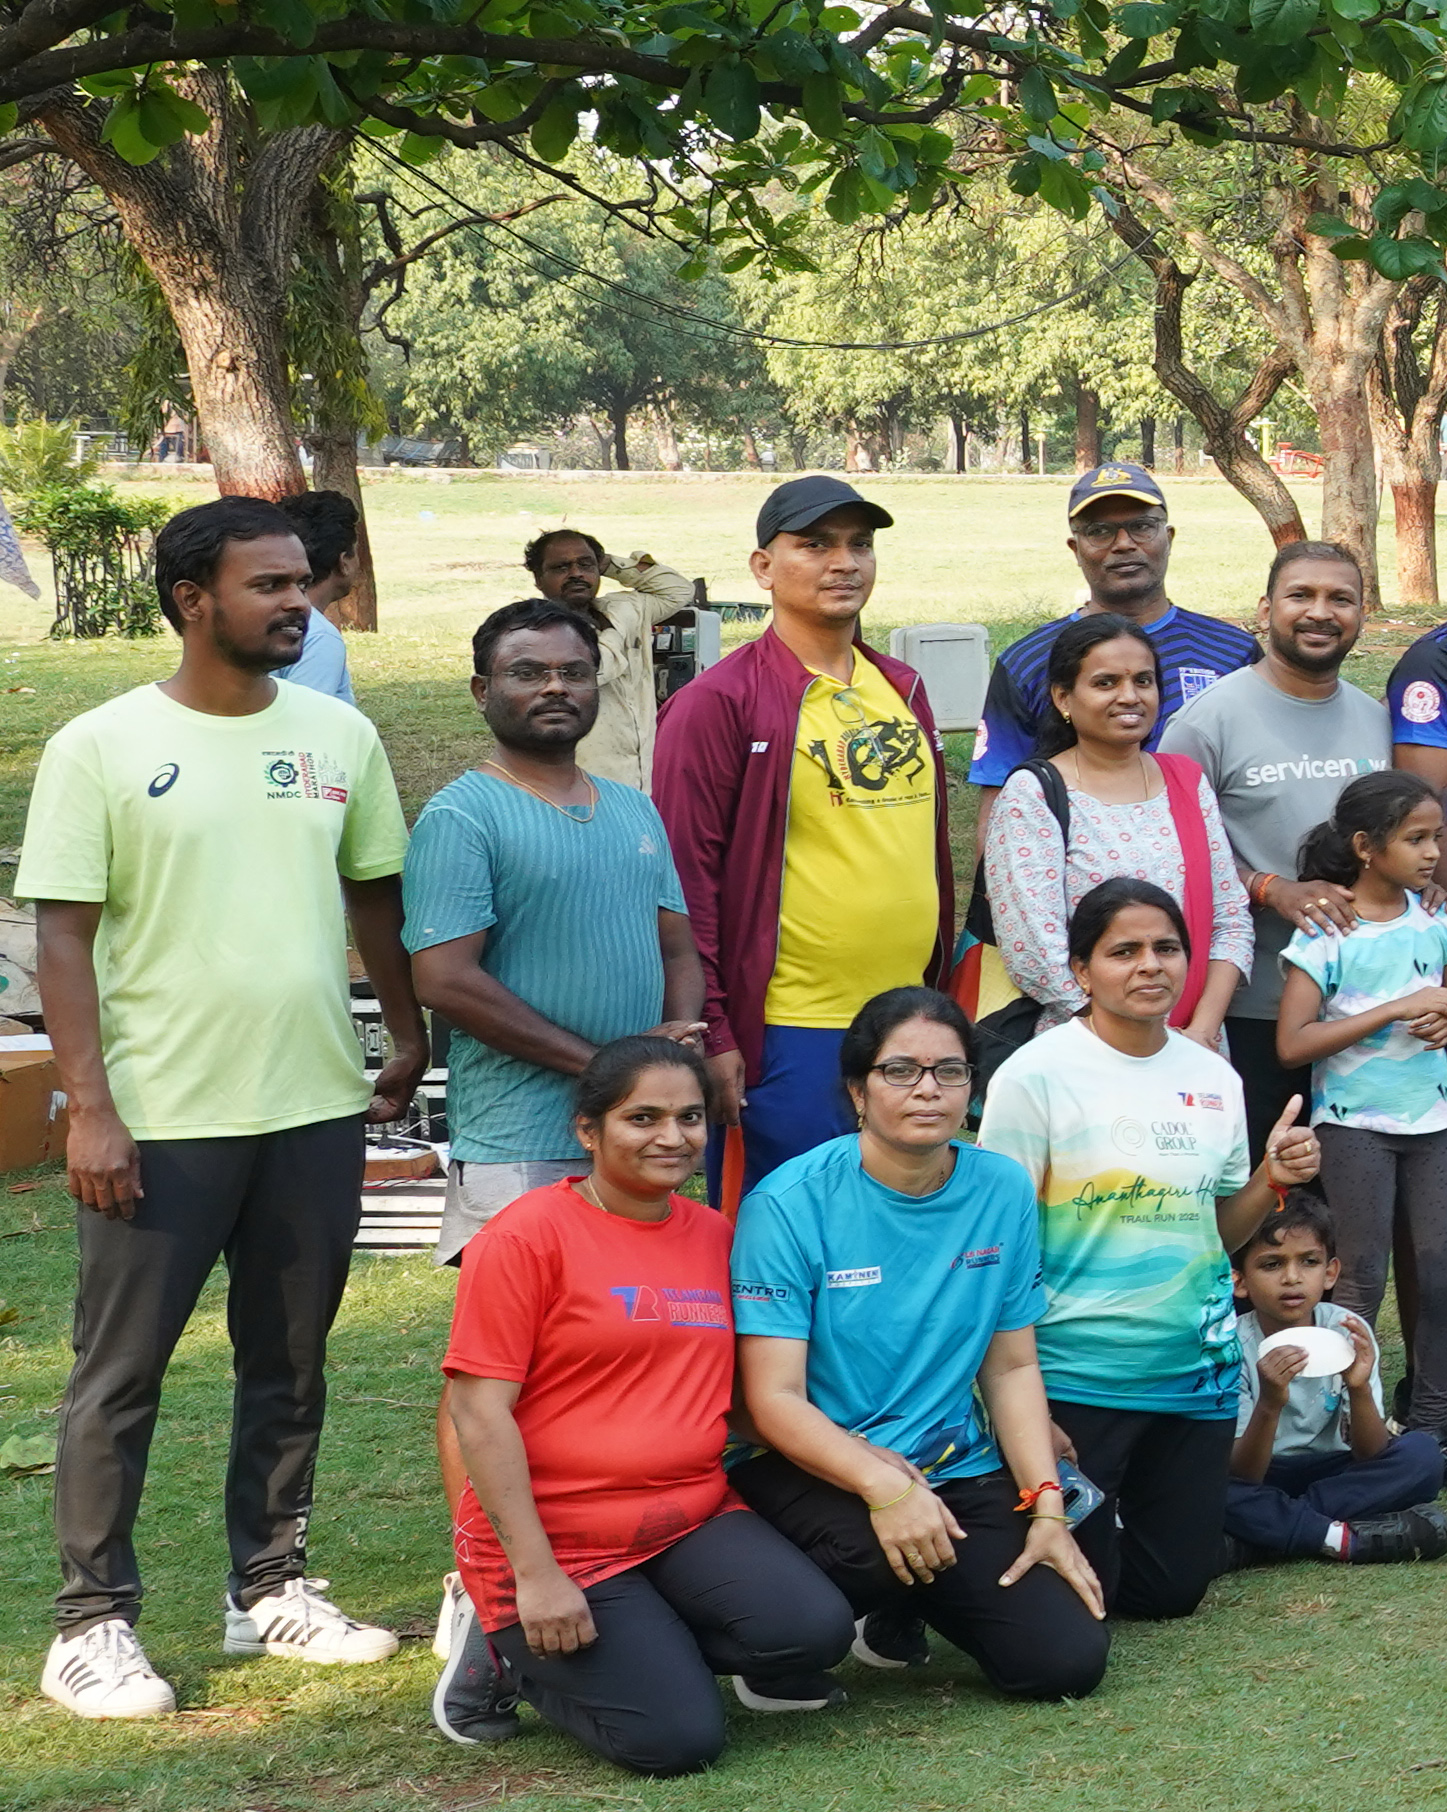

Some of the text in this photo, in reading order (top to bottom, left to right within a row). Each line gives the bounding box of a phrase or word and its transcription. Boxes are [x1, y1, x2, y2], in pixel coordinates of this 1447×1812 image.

[1247, 754, 1391, 787] servicenow
[266, 791, 302, 800] NMDC
[1151, 1121, 1193, 1136] CADOL
[1155, 1136, 1197, 1151] GROUP
[1072, 1175, 1192, 1221] Ananthagiri
[1120, 1214, 1152, 1225] TRAIL
[1154, 1213, 1176, 1223] RUN
[732, 1284, 788, 1298] ENTRO
